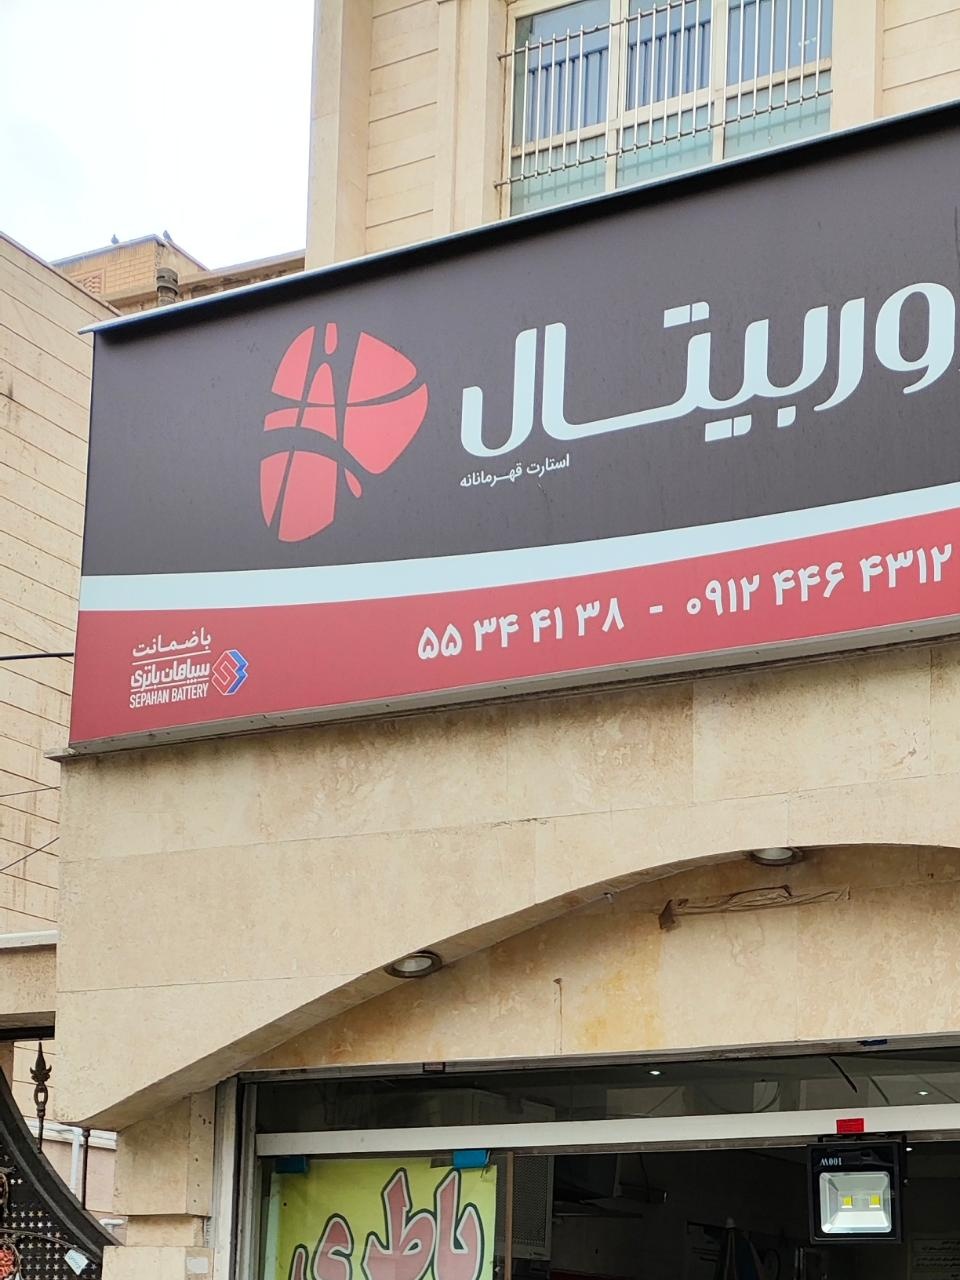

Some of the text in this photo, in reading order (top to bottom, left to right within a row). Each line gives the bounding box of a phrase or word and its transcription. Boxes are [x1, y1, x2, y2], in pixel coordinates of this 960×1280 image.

[460, 453, 570, 487] استارت قهرمانانه
[417, 625, 463, 661] ۵۵
[472, 614, 519, 652] ۳۴
[532, 608, 563, 643] ۴۱
[574, 597, 625, 637] ۳۸
[686, 573, 760, 616] ۰۹۱۲
[774, 561, 845, 606] ۴۴۶
[860, 543, 953, 593] ۴۳۱۲
[130, 664, 161, 691] باتری
[129, 682, 209, 709] SEPAHAN BATTERY
[820, 1158, 842, 1166] 100W
